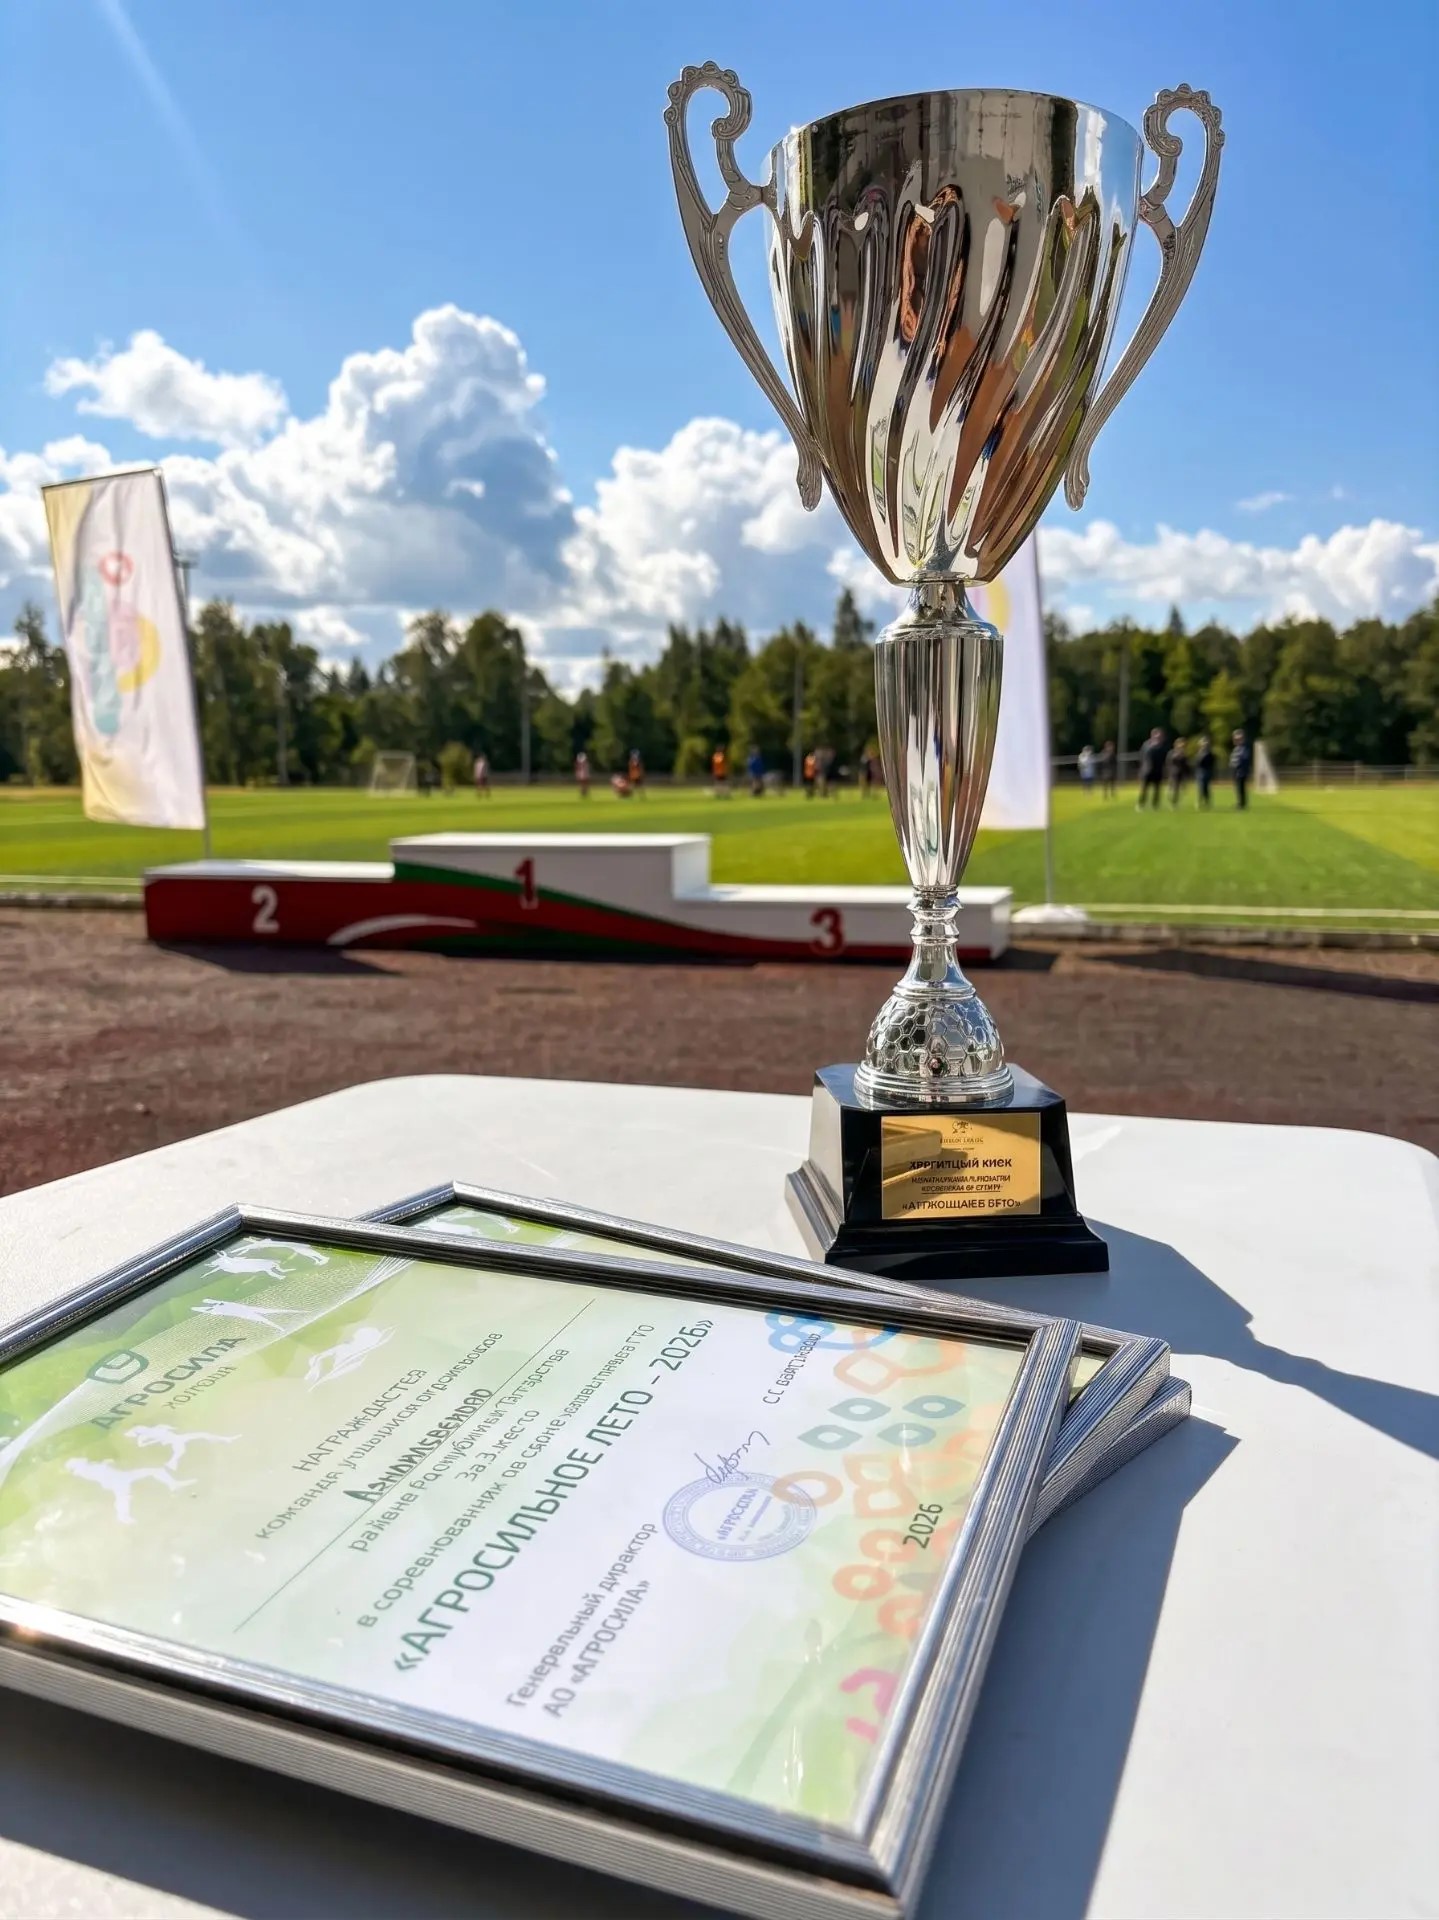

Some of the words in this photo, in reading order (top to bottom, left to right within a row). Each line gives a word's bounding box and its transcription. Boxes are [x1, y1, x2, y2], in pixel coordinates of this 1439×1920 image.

[514, 858, 539, 909] 1
[252, 886, 280, 934] 2
[809, 906, 846, 956] 3
[89, 1336, 247, 1430] АГРОСИЛА
[393, 1447, 605, 1671] «АГРОСИЛЬНОЕ
[584, 1389, 654, 1447] ЛЕТО
[901, 1502, 944, 1550] 2026
[569, 1579, 650, 1684] «АГРОСИЛА»
